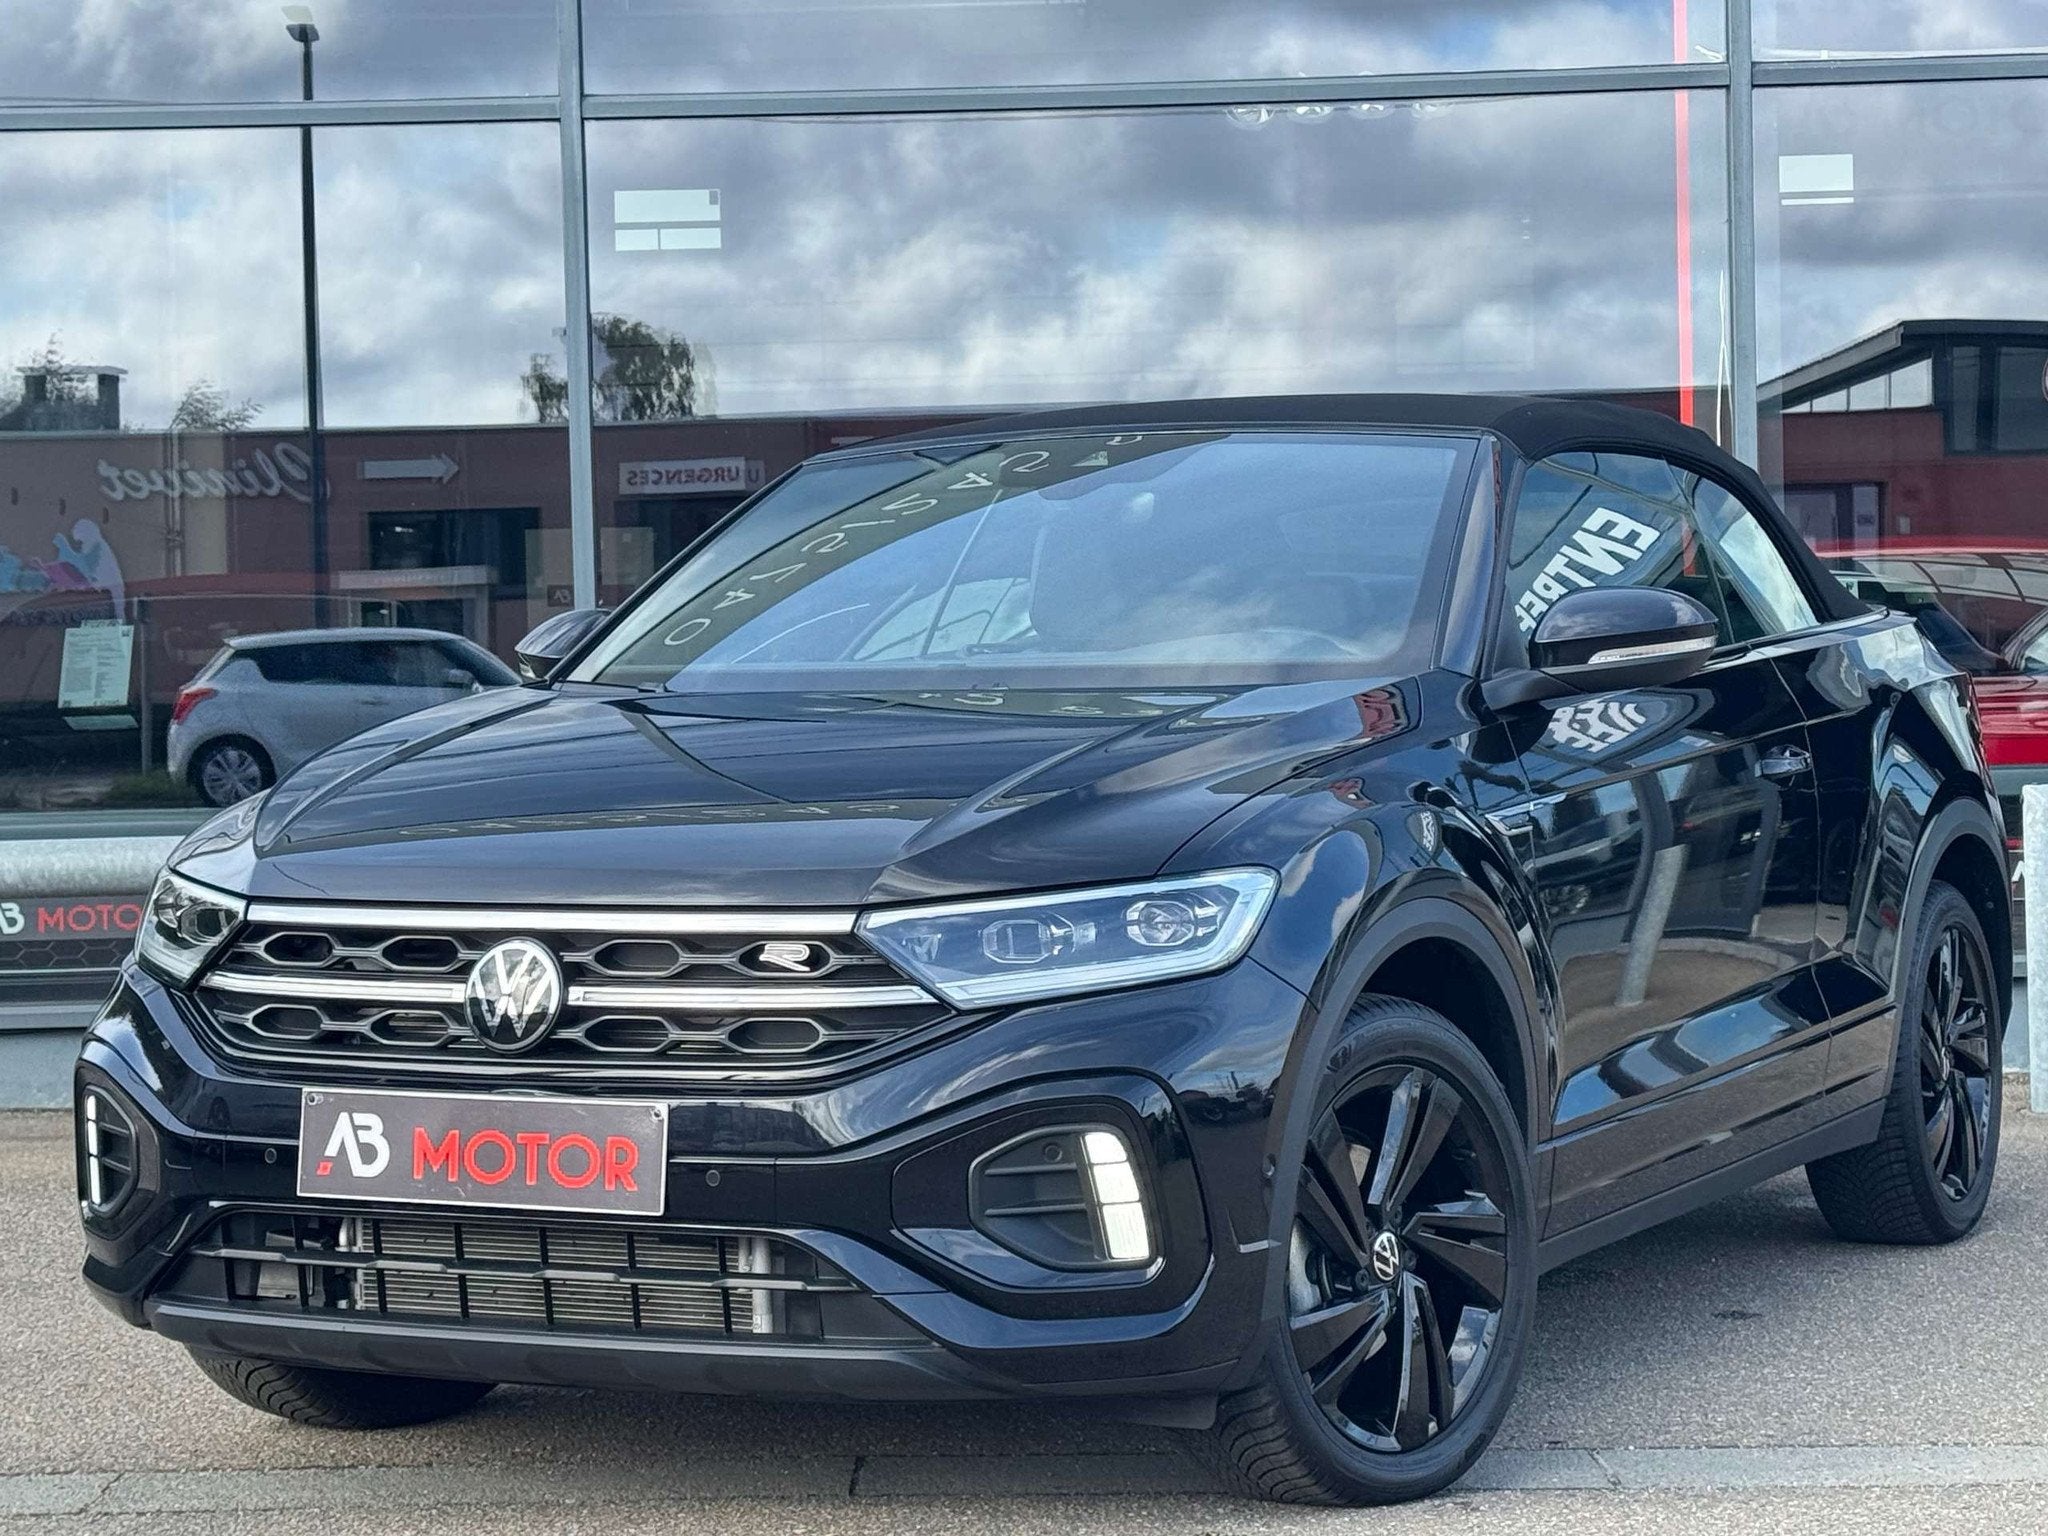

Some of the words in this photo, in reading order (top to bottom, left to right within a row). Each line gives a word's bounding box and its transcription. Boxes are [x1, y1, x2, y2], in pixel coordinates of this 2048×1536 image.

[0, 902, 25, 935] B
[36, 903, 142, 934] MOTO
[317, 1111, 390, 1178] AB
[412, 1126, 639, 1192] MOTOR
